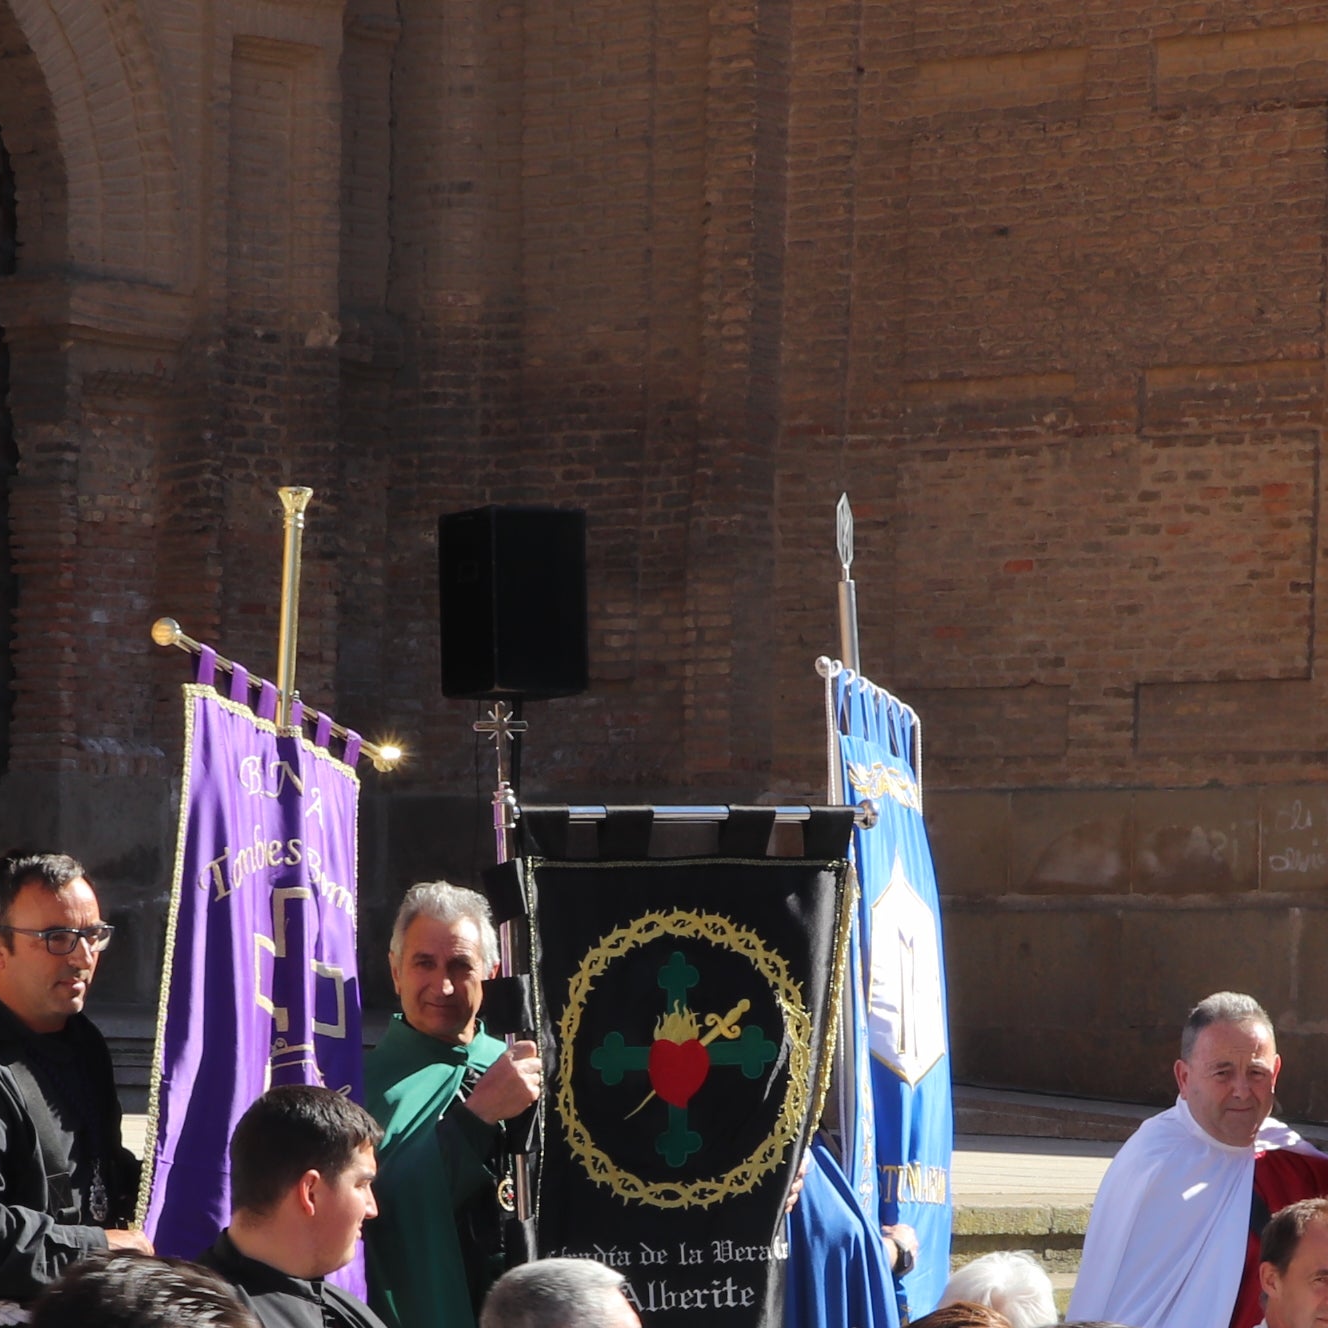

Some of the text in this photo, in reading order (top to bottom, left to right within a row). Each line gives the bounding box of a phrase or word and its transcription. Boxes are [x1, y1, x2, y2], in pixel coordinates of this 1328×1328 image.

[638, 1241, 668, 1266] de
[678, 1241, 704, 1266] la
[621, 1276, 756, 1313] Alberite
